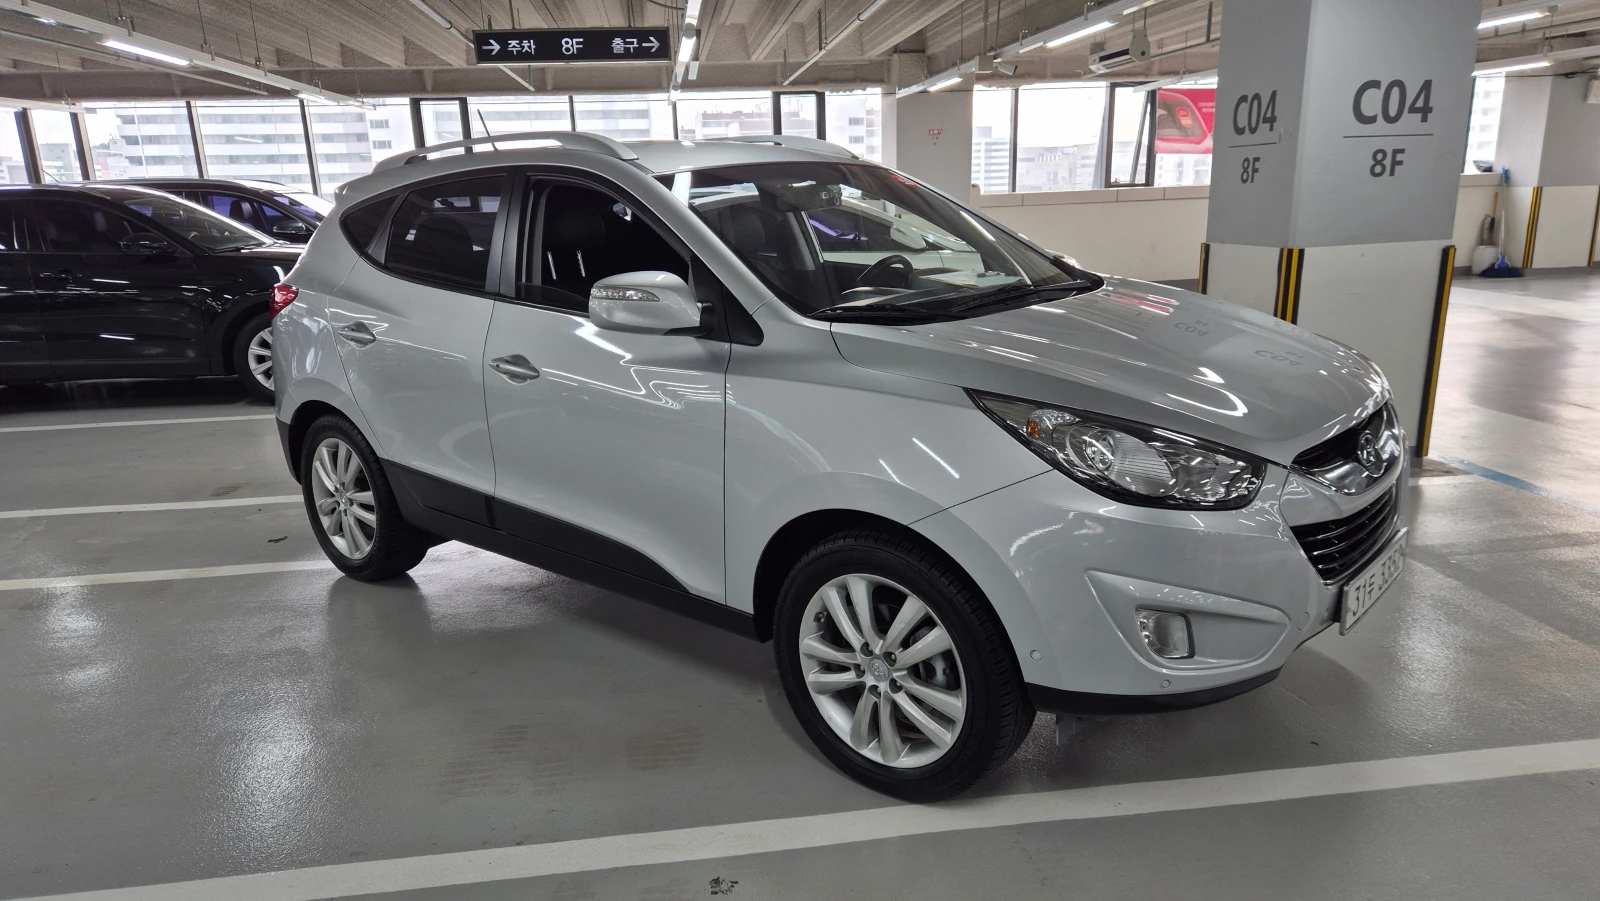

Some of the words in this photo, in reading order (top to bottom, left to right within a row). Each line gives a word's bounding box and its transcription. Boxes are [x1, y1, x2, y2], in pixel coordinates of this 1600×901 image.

[507, 39, 536, 55] 주차
[561, 37, 584, 55] 8F
[611, 37, 639, 54] 출구
[1232, 89, 1279, 136] C04
[1352, 79, 1434, 126] C04
[1240, 156, 1261, 184] 8F
[1369, 148, 1406, 178] 8F
